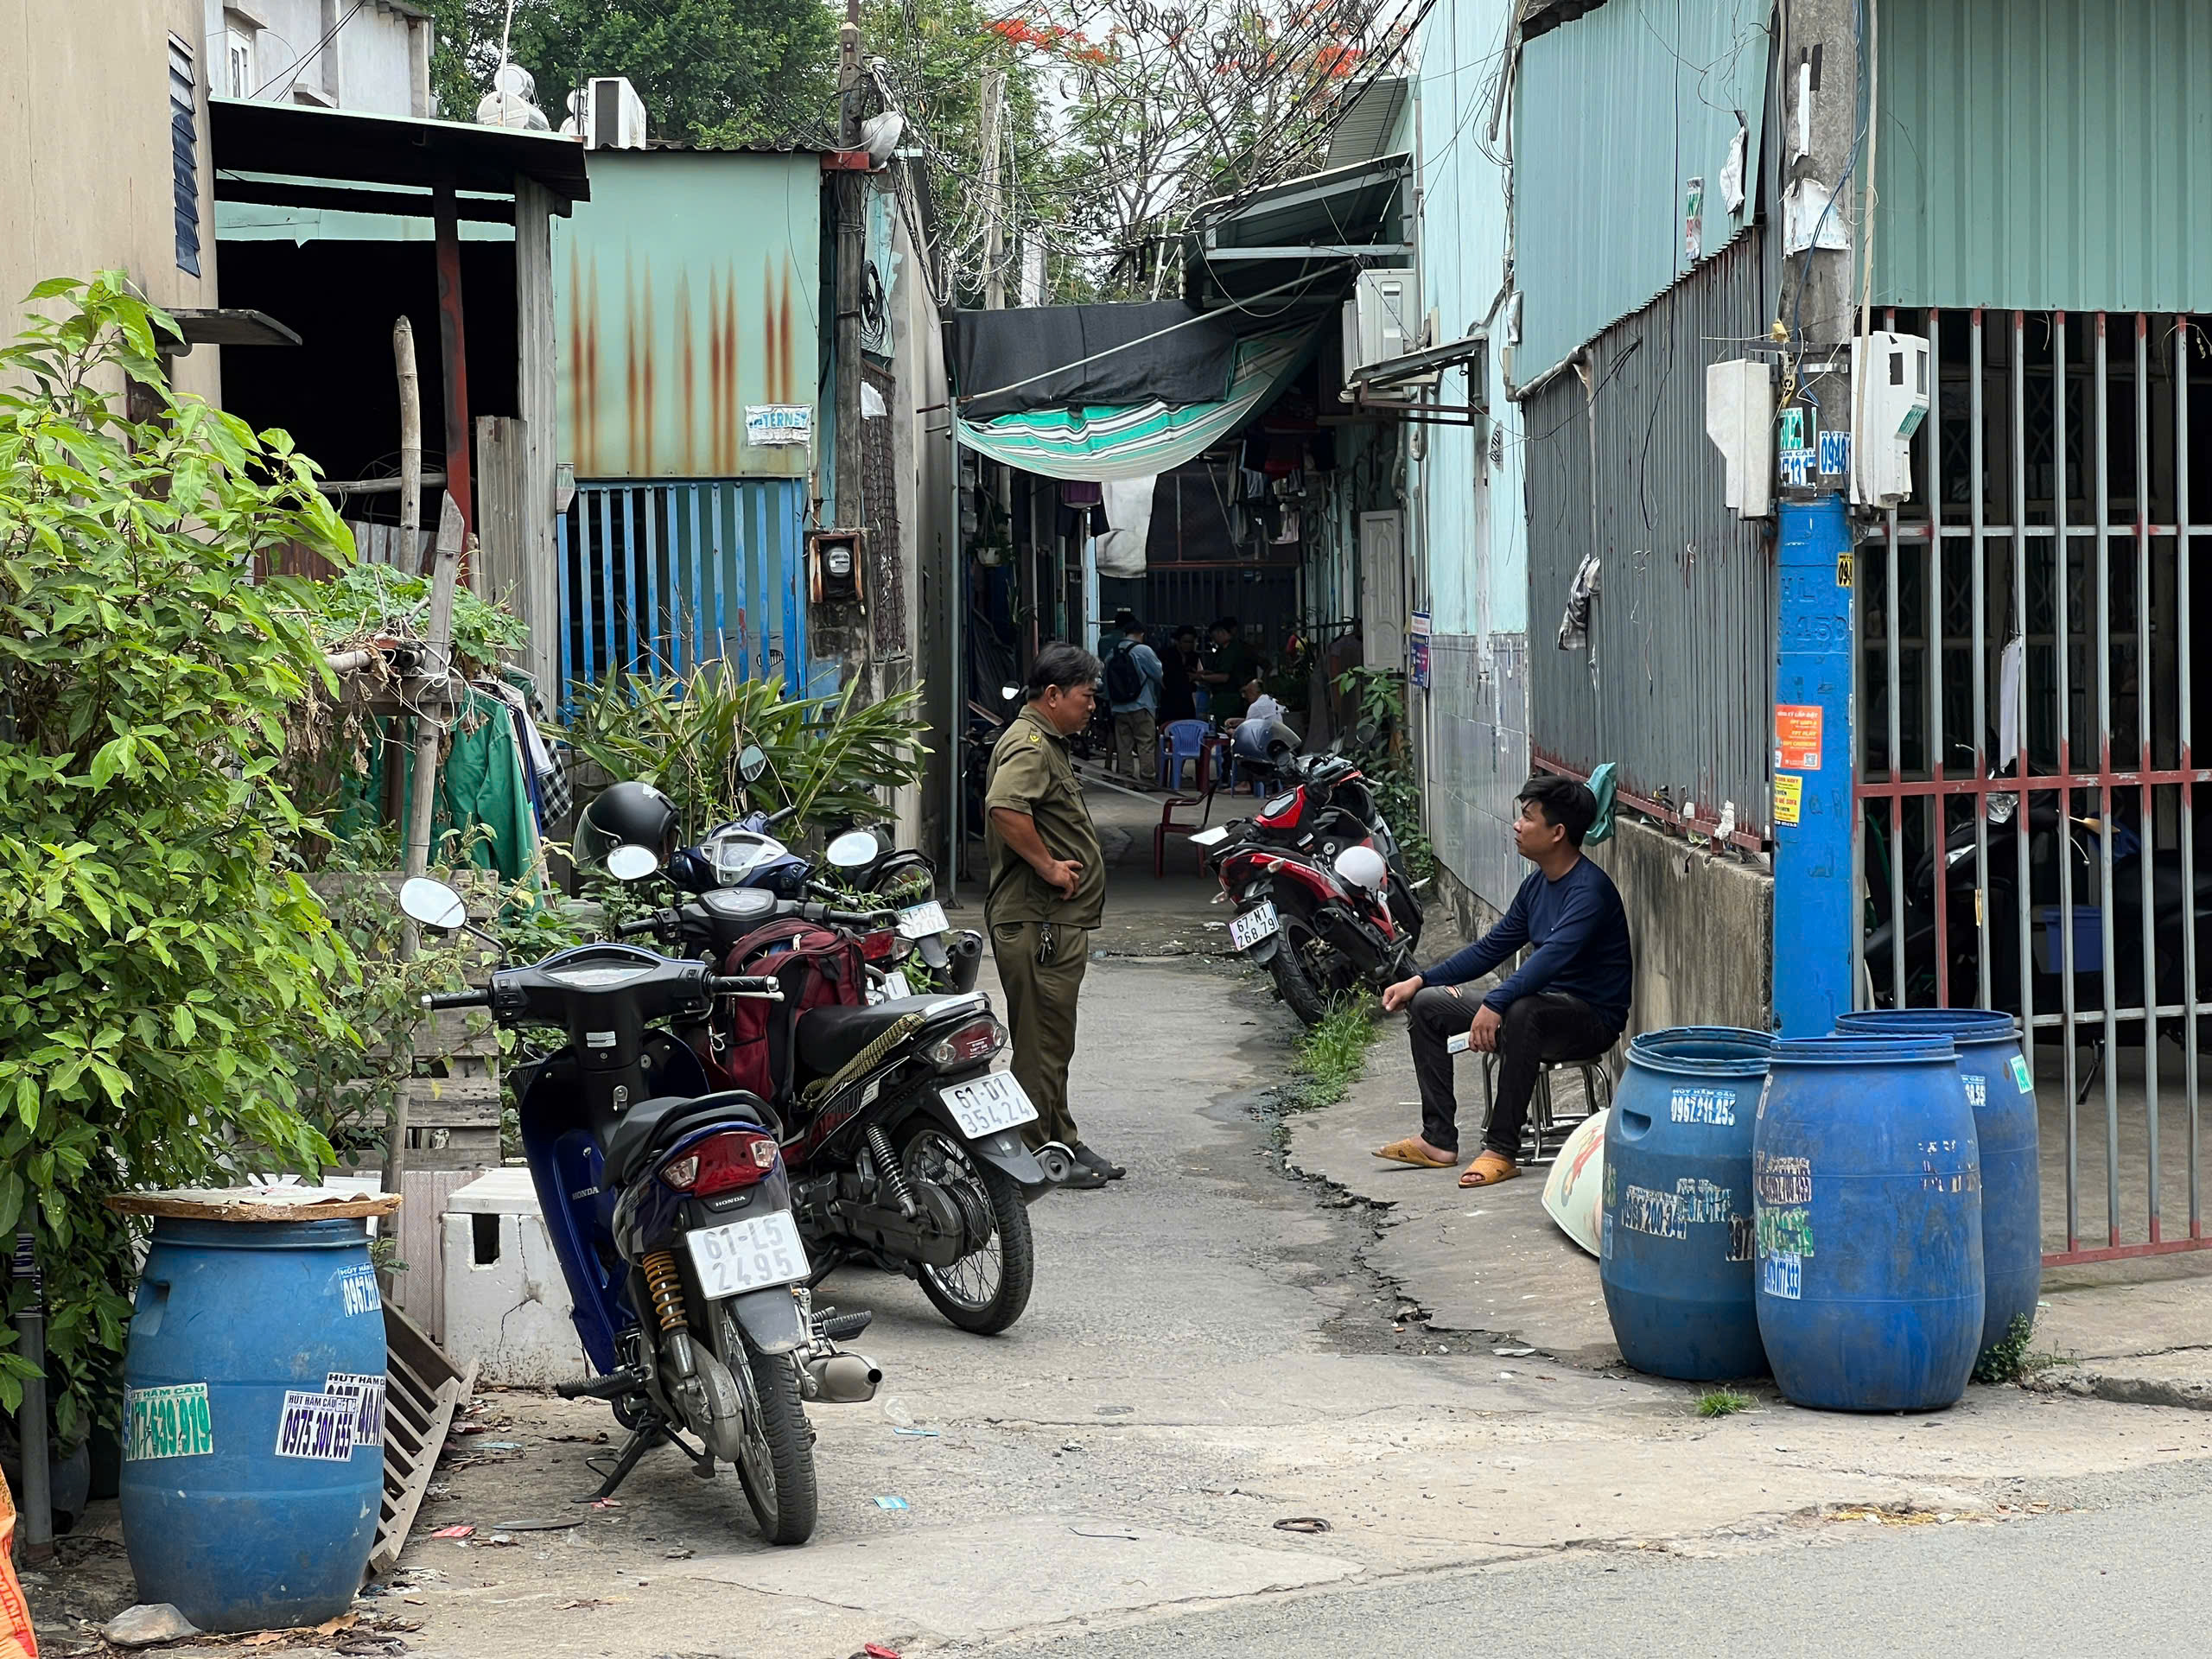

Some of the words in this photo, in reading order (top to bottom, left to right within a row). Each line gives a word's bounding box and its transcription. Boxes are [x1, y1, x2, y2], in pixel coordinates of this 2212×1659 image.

[1821, 436, 1851, 474] 0948.
[1236, 906, 1268, 933] 67-N1
[1237, 918, 1275, 949] 268.79
[955, 1077, 1009, 1109] 61-D1
[961, 1097, 1031, 1134] 354.24
[572, 1185, 600, 1201] HONDA
[715, 1195, 746, 1207] HONDA
[703, 1217, 783, 1260] 61-L5
[712, 1248, 793, 1292] 2495
[282, 1408, 353, 1459] 0975.300.655
